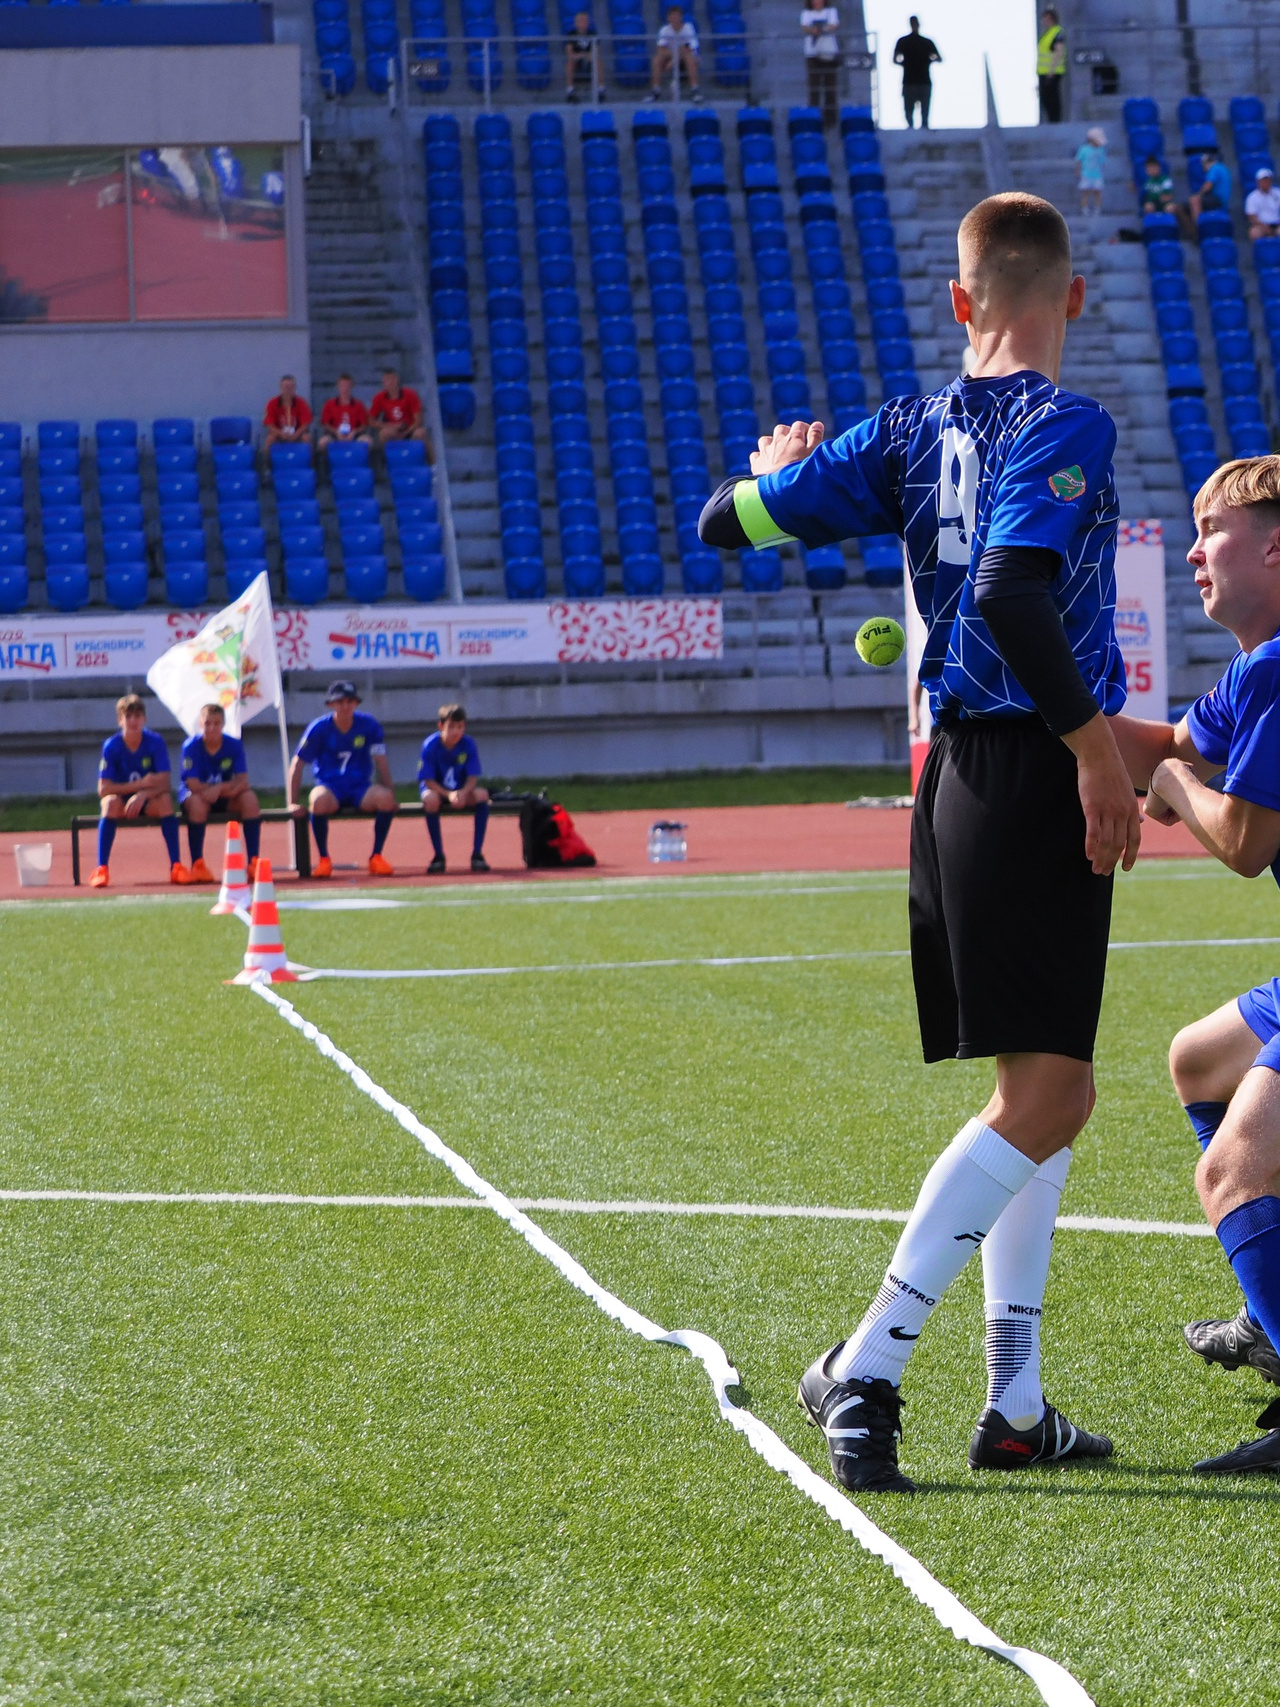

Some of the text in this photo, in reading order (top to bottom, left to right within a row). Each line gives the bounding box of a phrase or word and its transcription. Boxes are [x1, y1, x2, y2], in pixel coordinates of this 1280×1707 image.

[938, 426, 980, 565] 9
[863, 624, 891, 640] FILA
[354, 630, 440, 660] ЛАПТА
[76, 652, 109, 668] 2025
[337, 751, 352, 775] 7
